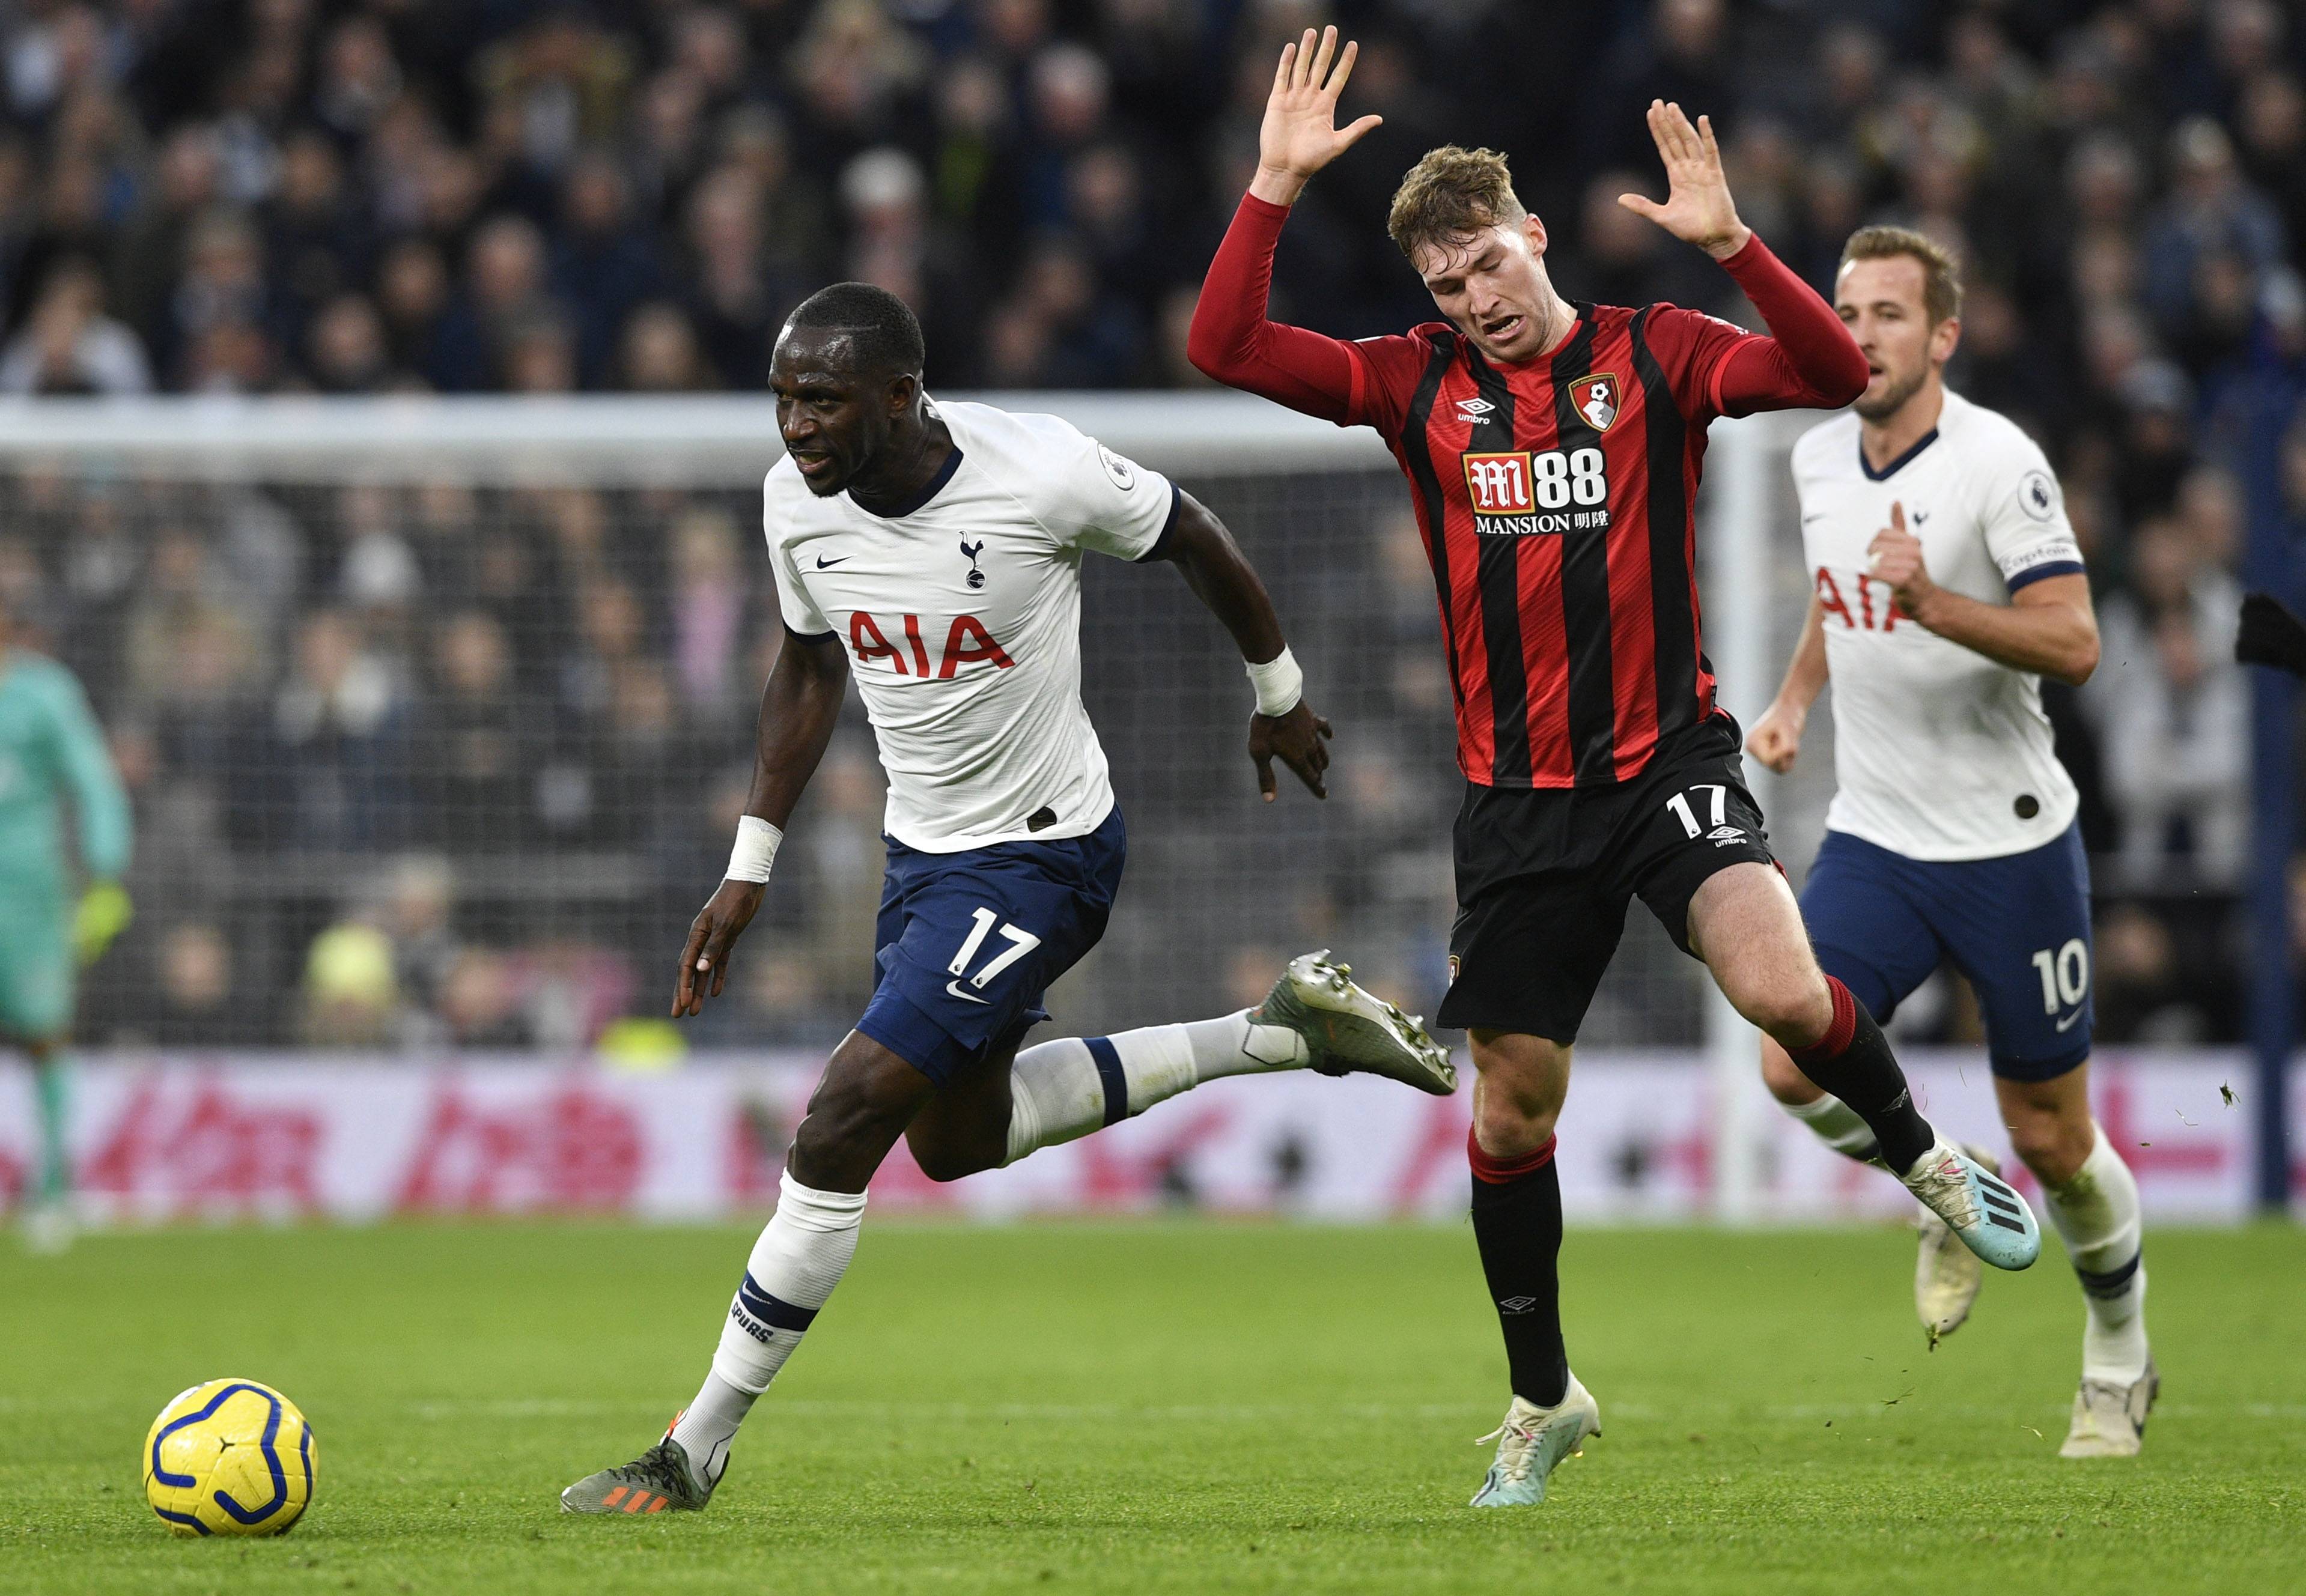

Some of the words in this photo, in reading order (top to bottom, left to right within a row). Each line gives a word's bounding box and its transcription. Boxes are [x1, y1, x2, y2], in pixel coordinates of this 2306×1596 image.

[1457, 413, 1490, 425] umbro
[1475, 514, 1571, 535] MANSION
[1574, 509, 1609, 530] 明陞
[850, 611, 1016, 679] AIA
[1666, 784, 1726, 840] 17
[1714, 837, 1747, 848] umbro
[947, 906, 1042, 989] 17
[2031, 938, 2088, 1015] 10
[731, 1301, 774, 1343] SPURS
